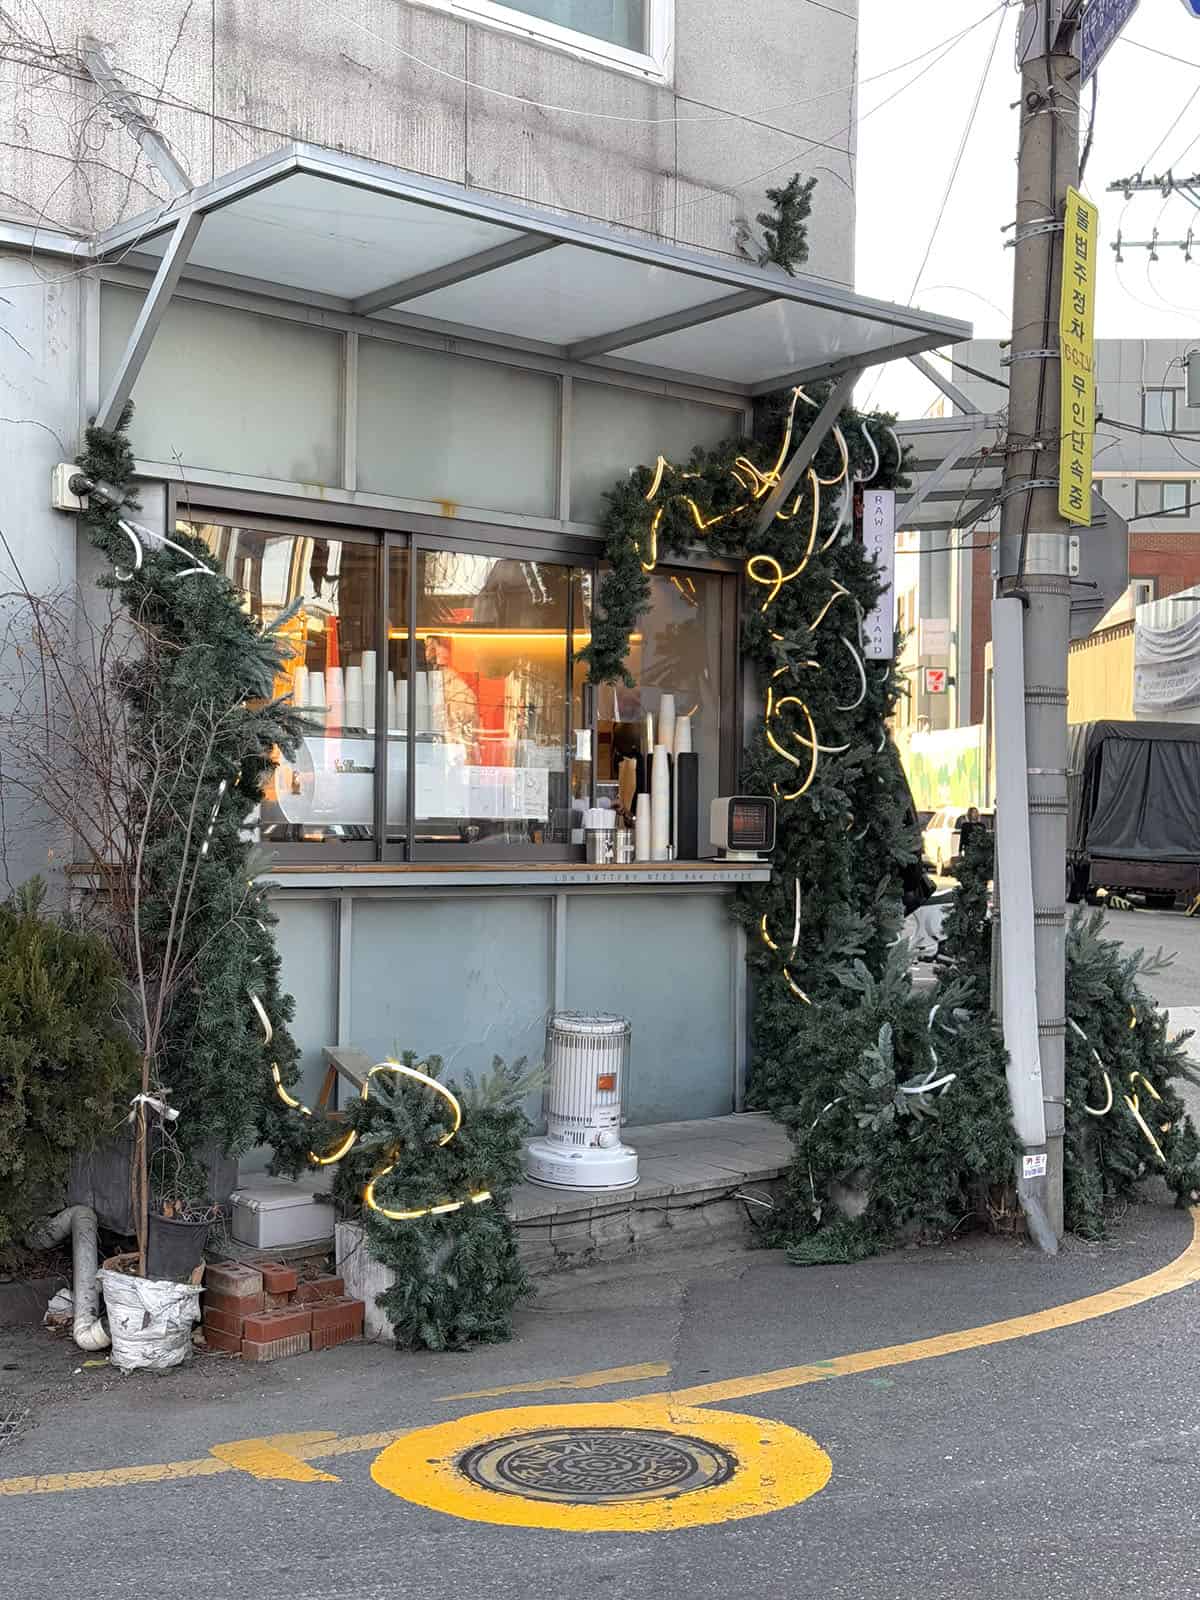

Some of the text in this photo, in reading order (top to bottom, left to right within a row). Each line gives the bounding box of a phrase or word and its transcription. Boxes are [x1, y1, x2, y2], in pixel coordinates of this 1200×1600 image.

[1071, 206, 1089, 344] 불법주정차
[1069, 375, 1086, 510] 무인단속중
[874, 495, 883, 526] RAW
